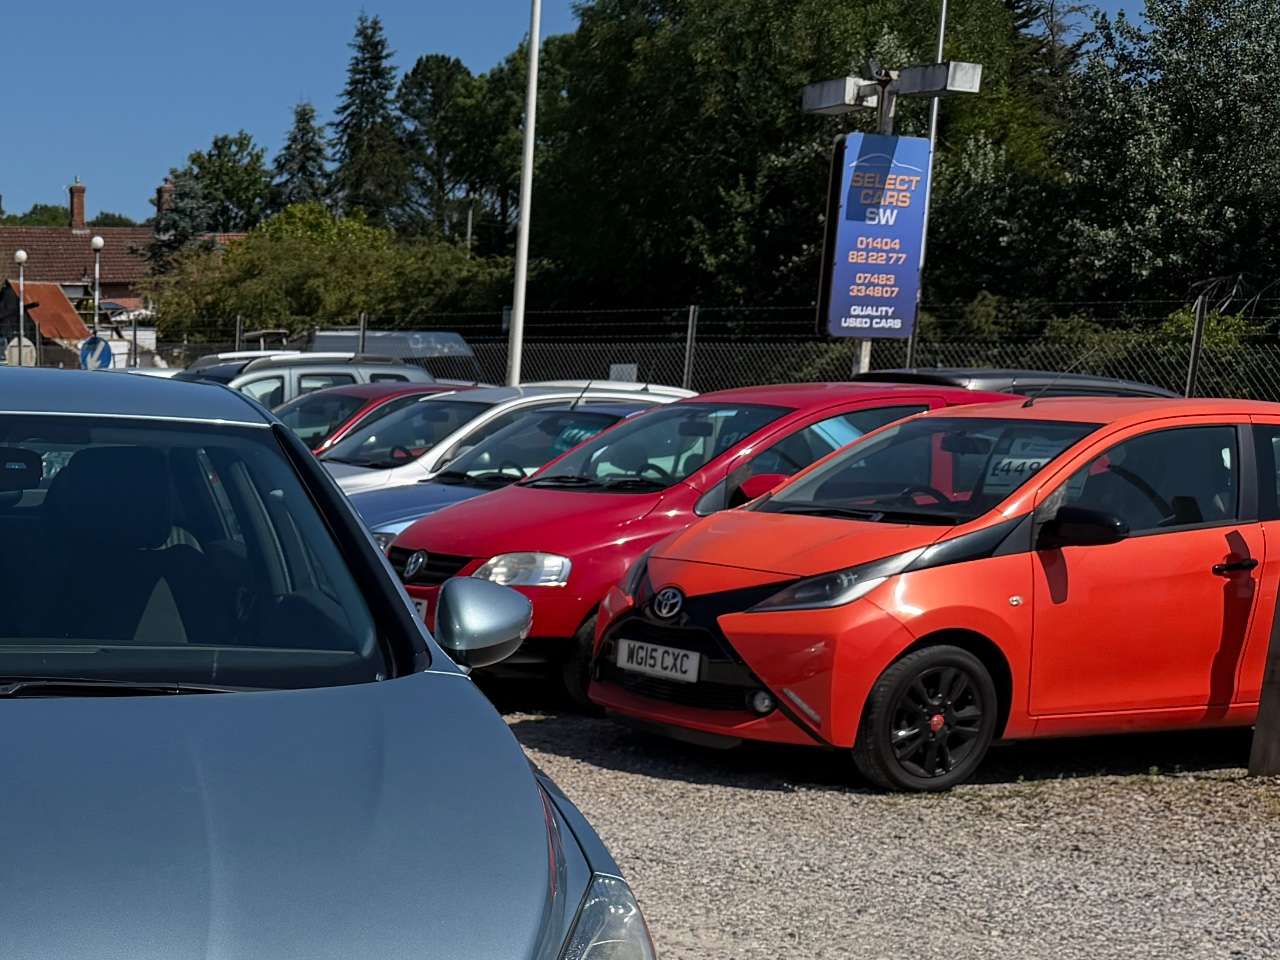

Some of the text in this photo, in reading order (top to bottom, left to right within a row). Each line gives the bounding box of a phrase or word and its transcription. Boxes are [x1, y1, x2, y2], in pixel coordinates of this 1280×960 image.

[852, 172, 921, 190] SELECT
[861, 189, 911, 207] CARS
[865, 208, 897, 225] SW
[857, 237, 900, 250] 01404
[855, 273, 895, 285] 07483
[849, 285, 899, 297] 334807
[850, 305, 894, 316] QUALITY
[841, 317, 902, 328] USED CARS
[627, 642, 689, 675] WG15 CXC
